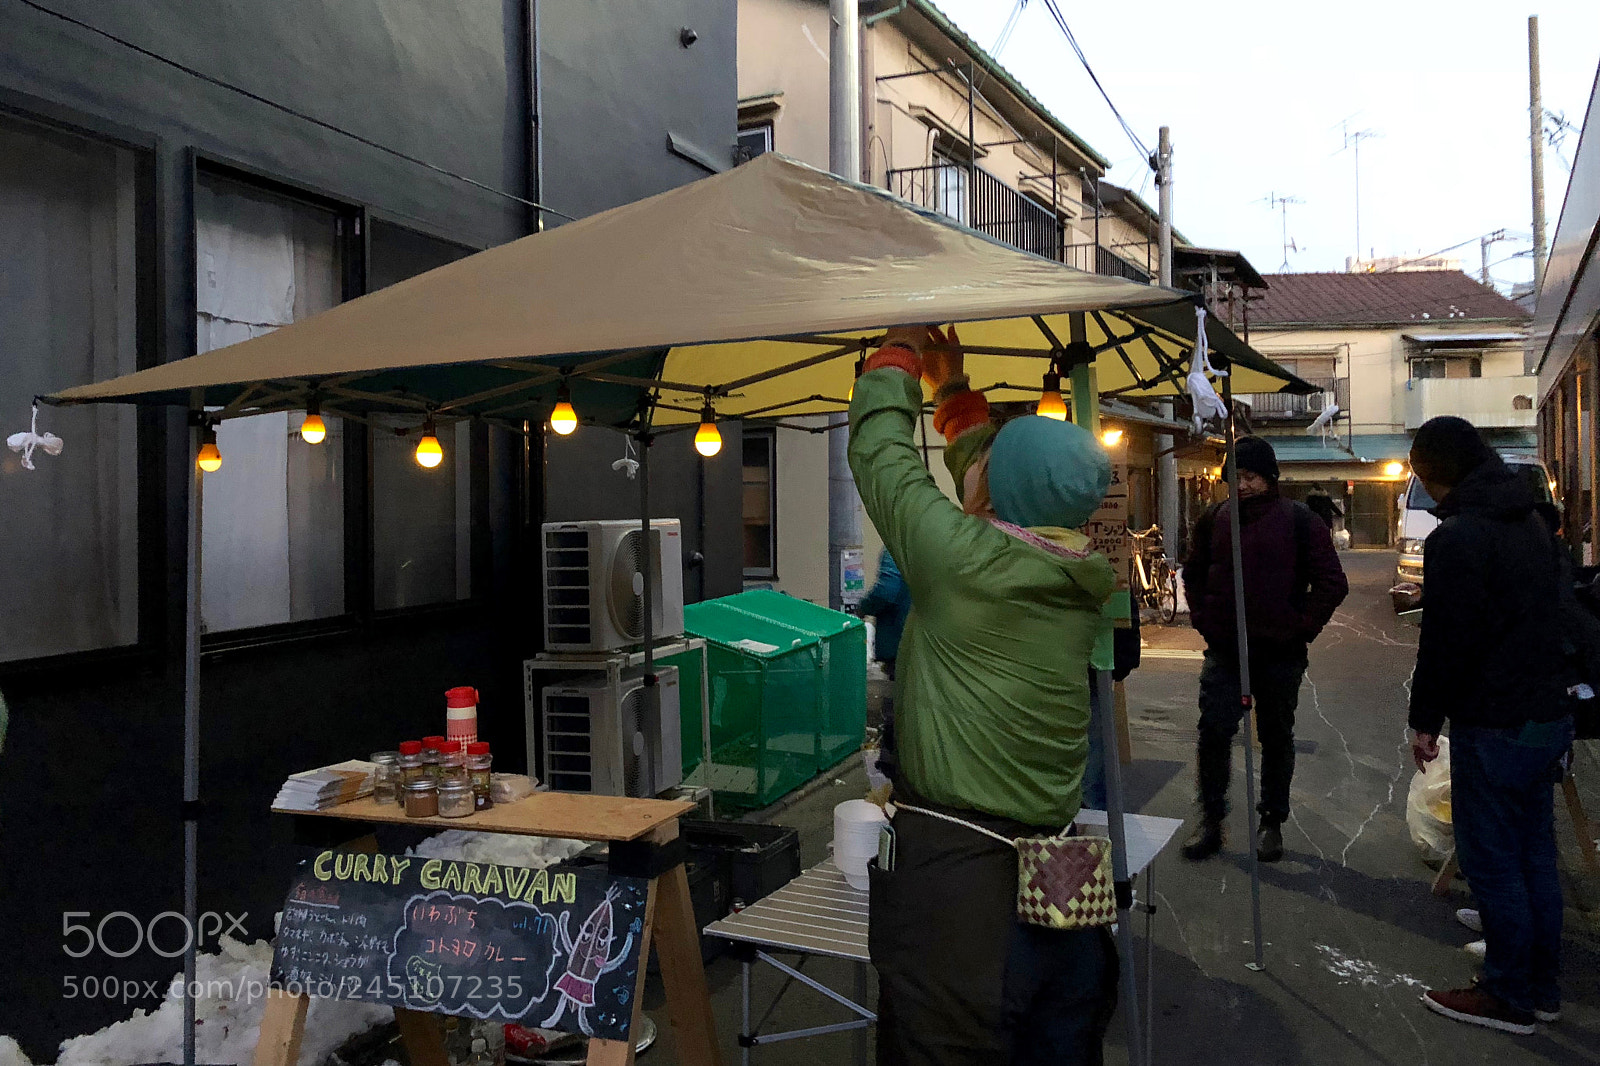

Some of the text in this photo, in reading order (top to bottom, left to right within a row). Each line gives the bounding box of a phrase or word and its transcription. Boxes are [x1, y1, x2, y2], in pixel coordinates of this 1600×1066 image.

[313, 850, 577, 904] CURRY CARAVAN
[412, 905, 478, 929] いわぶち
[484, 941, 527, 962] カレー
